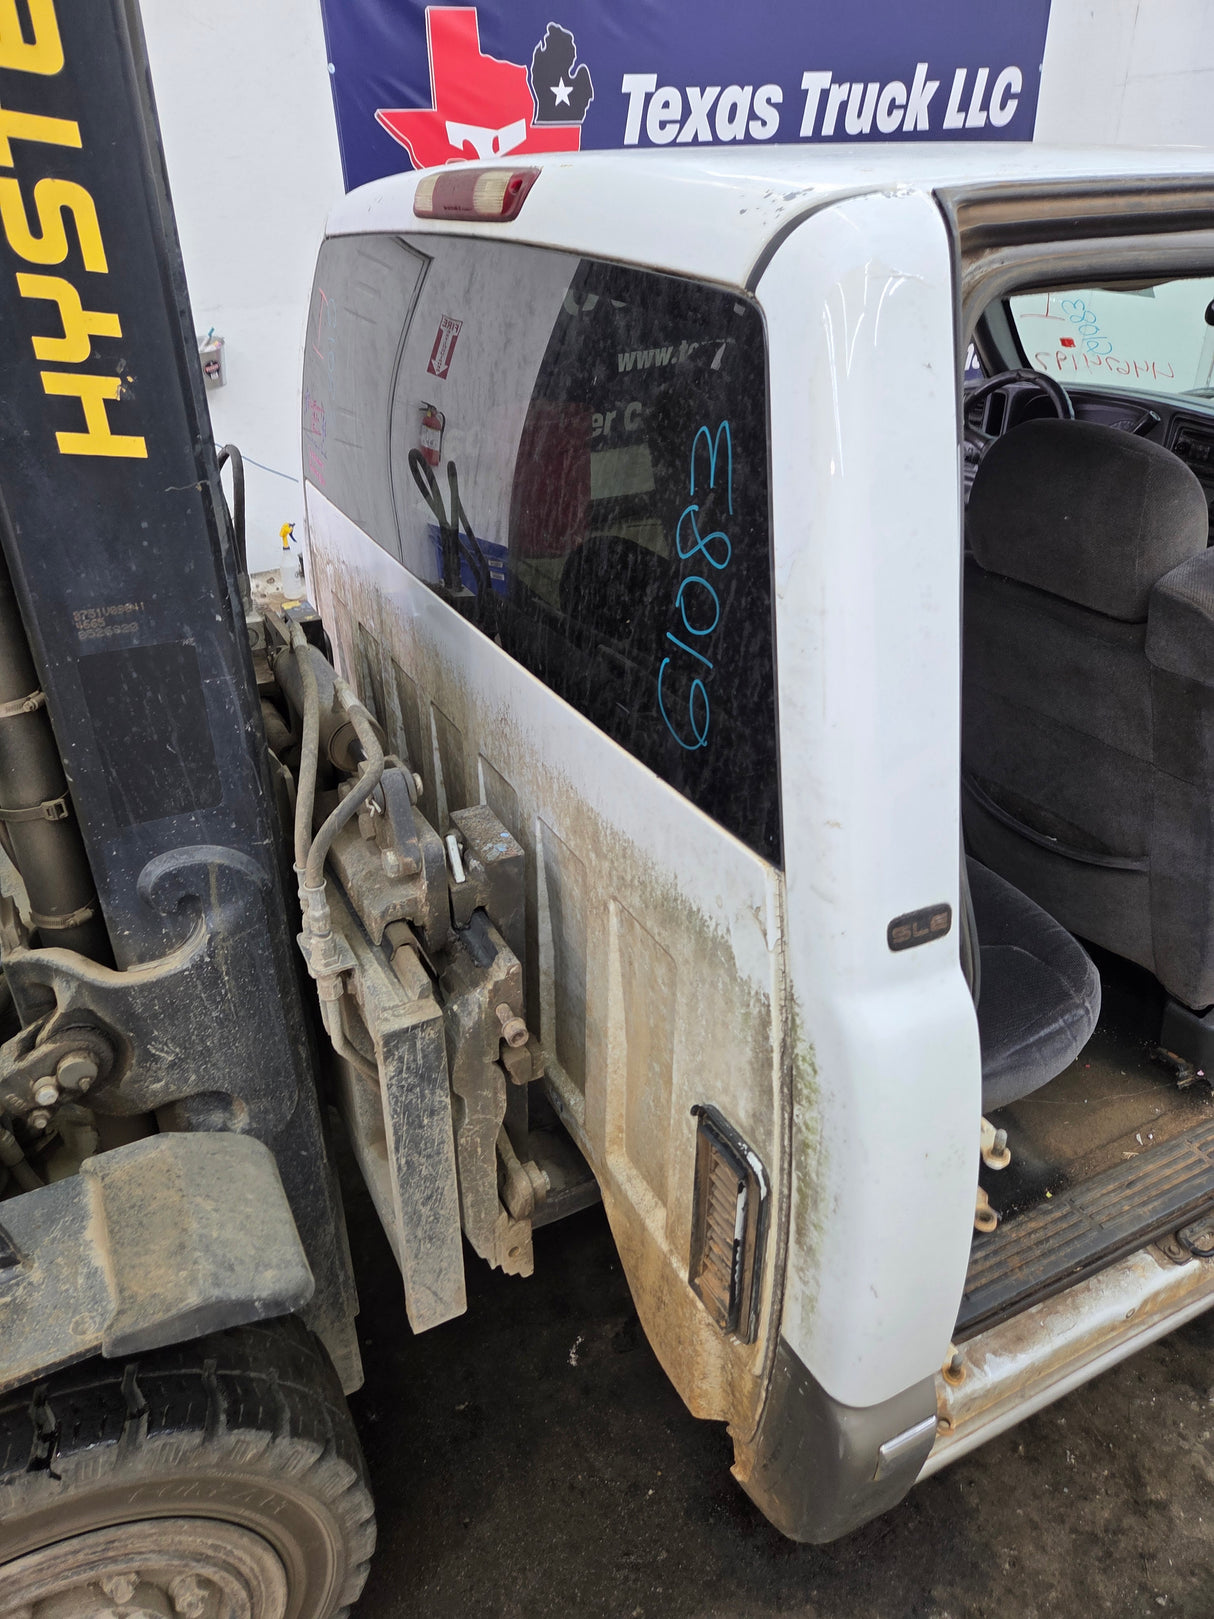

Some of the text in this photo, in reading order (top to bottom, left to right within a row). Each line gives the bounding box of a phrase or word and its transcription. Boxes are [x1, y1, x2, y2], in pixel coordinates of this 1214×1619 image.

[621, 62, 1022, 145] Texas Truck LLC
[658, 420, 733, 750] 61083
